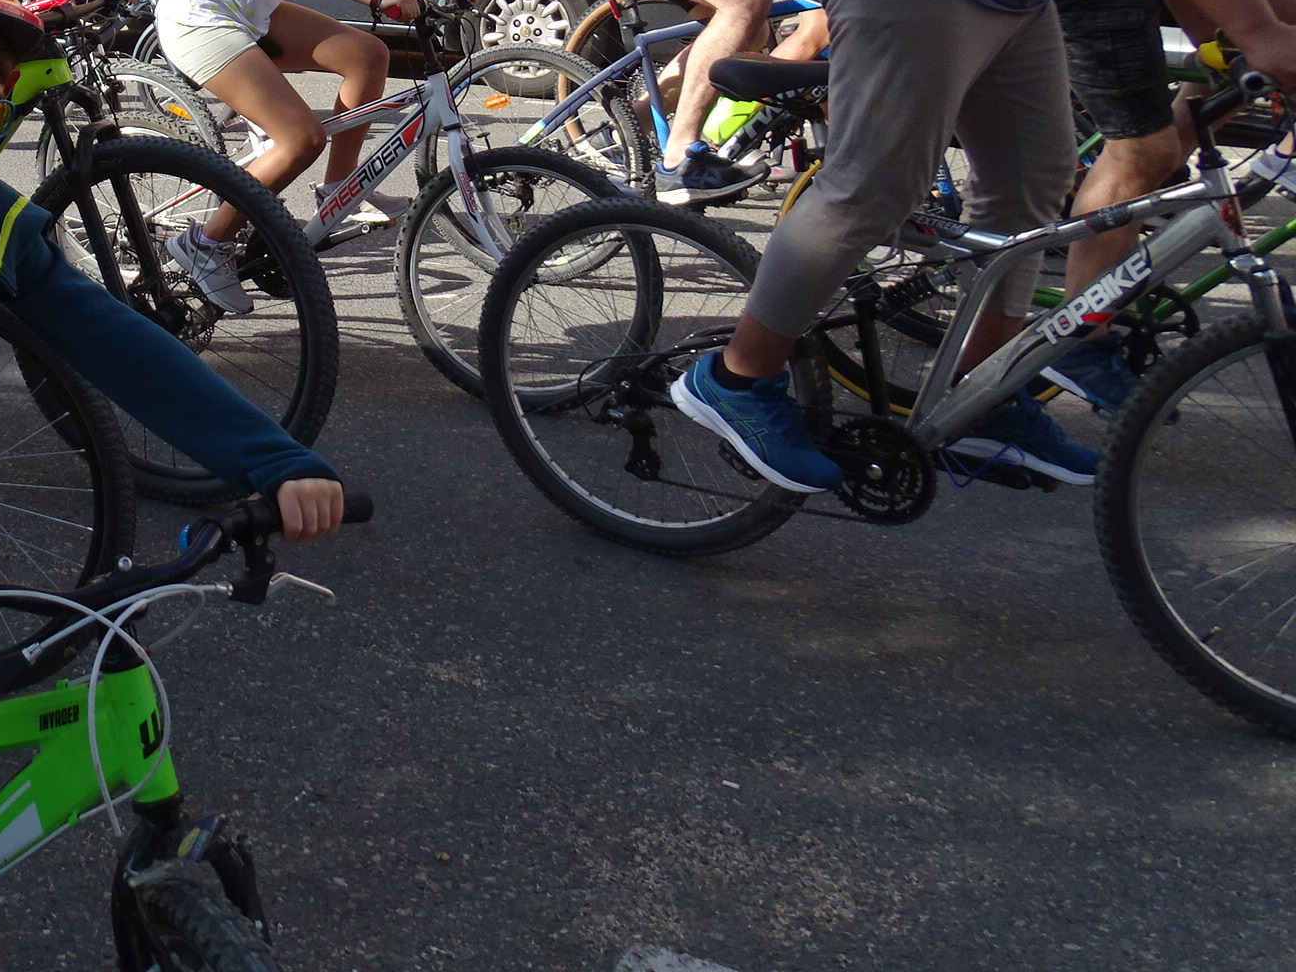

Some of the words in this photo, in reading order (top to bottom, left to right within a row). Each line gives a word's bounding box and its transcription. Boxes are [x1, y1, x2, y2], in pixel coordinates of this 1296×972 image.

[318, 136, 407, 226] FREERIDER
[916, 215, 970, 235] EXTREME
[1036, 251, 1153, 345] TOPBIKE
[38, 704, 80, 731] INVADER
